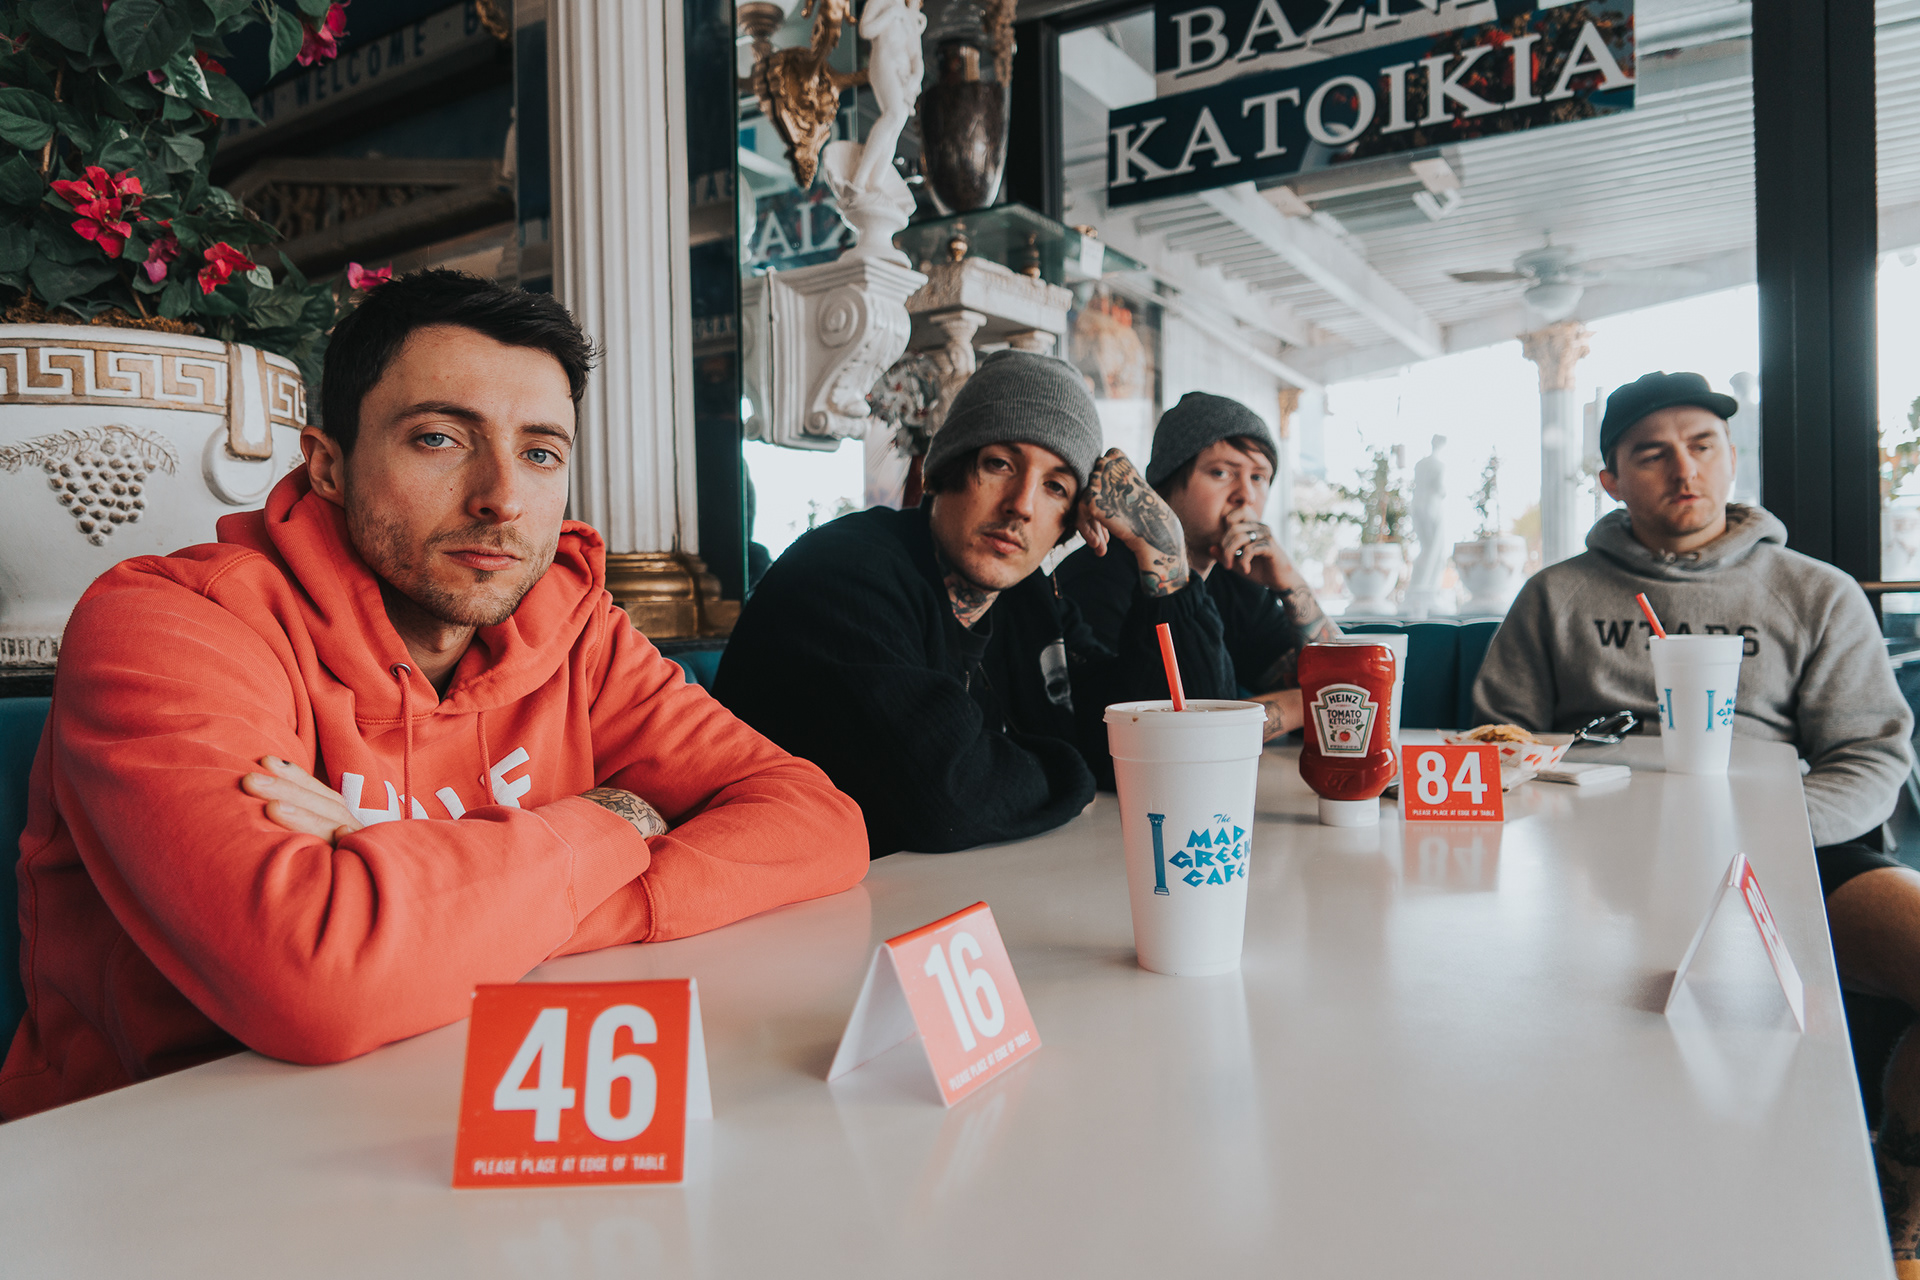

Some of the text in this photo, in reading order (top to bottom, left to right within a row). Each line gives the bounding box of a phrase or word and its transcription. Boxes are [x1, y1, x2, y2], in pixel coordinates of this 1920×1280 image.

[296, 22, 426, 105] WELCOME
[1328, 694, 1359, 704] HEINZ
[1327, 709, 1362, 718] TOMATO
[1416, 751, 1488, 805] 84
[1213, 813, 1231, 824] The
[1186, 824, 1246, 849] MAD
[1168, 838, 1250, 869] GREEK
[1182, 861, 1245, 887] CAFE
[924, 931, 1005, 1052] 16
[493, 1004, 658, 1142] 46
[948, 1029, 1032, 1092] PLEASE PLACE AT EDGE OF TABLE
[473, 1155, 665, 1175] PLEASE PLACE AT EDGE OF TABLE
